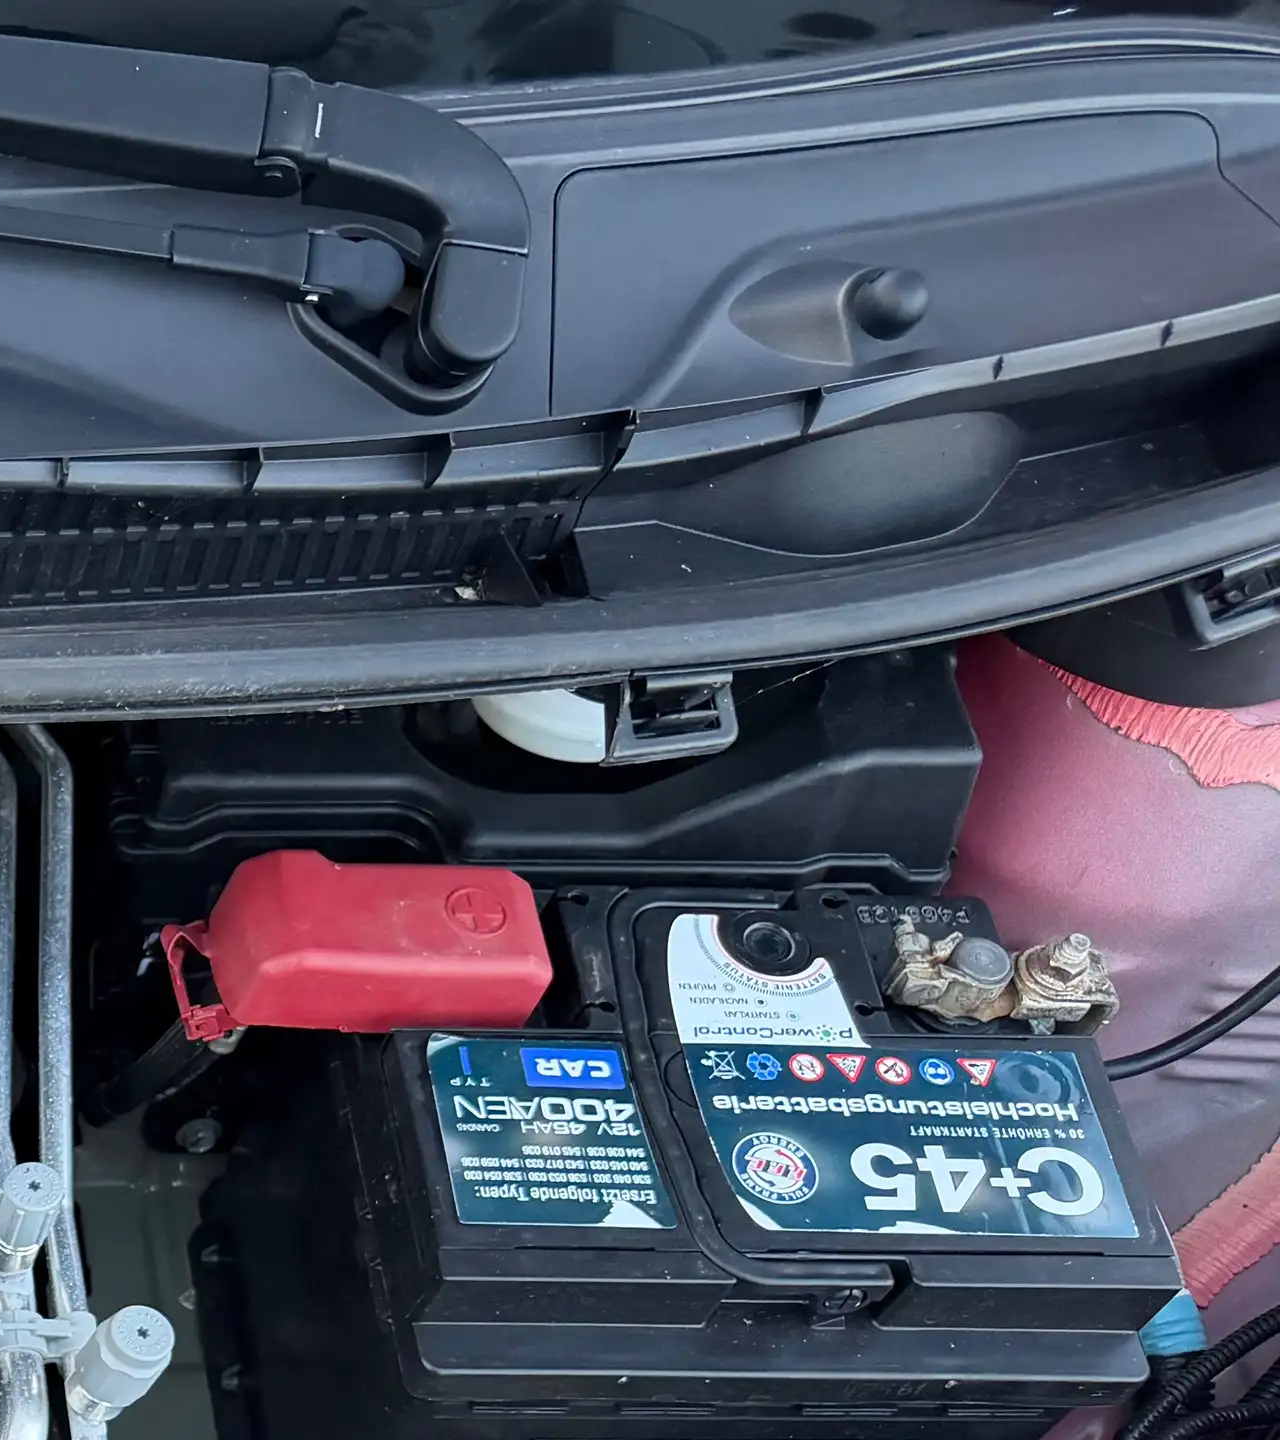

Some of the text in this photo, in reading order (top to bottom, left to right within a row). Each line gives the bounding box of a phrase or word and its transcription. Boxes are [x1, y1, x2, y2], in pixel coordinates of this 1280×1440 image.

[689, 996, 748, 1005] NACHLADEN
[724, 1010, 780, 1019] STARTKLAR
[534, 1058, 612, 1078] CAR
[712, 1094, 1079, 1121] Hochleistungsbatterie
[520, 1120, 587, 1134] 45AH
[596, 1122, 641, 1136] 12V
[910, 1125, 1085, 1140] 30 % ERHÖHTE STARTKRAFT
[752, 1135, 804, 1158] ENERGY
[740, 1172, 810, 1201] FULL FRAME
[850, 1142, 1104, 1216] C+45
[474, 1184, 657, 1204] Ersetzt folgende Typen:
